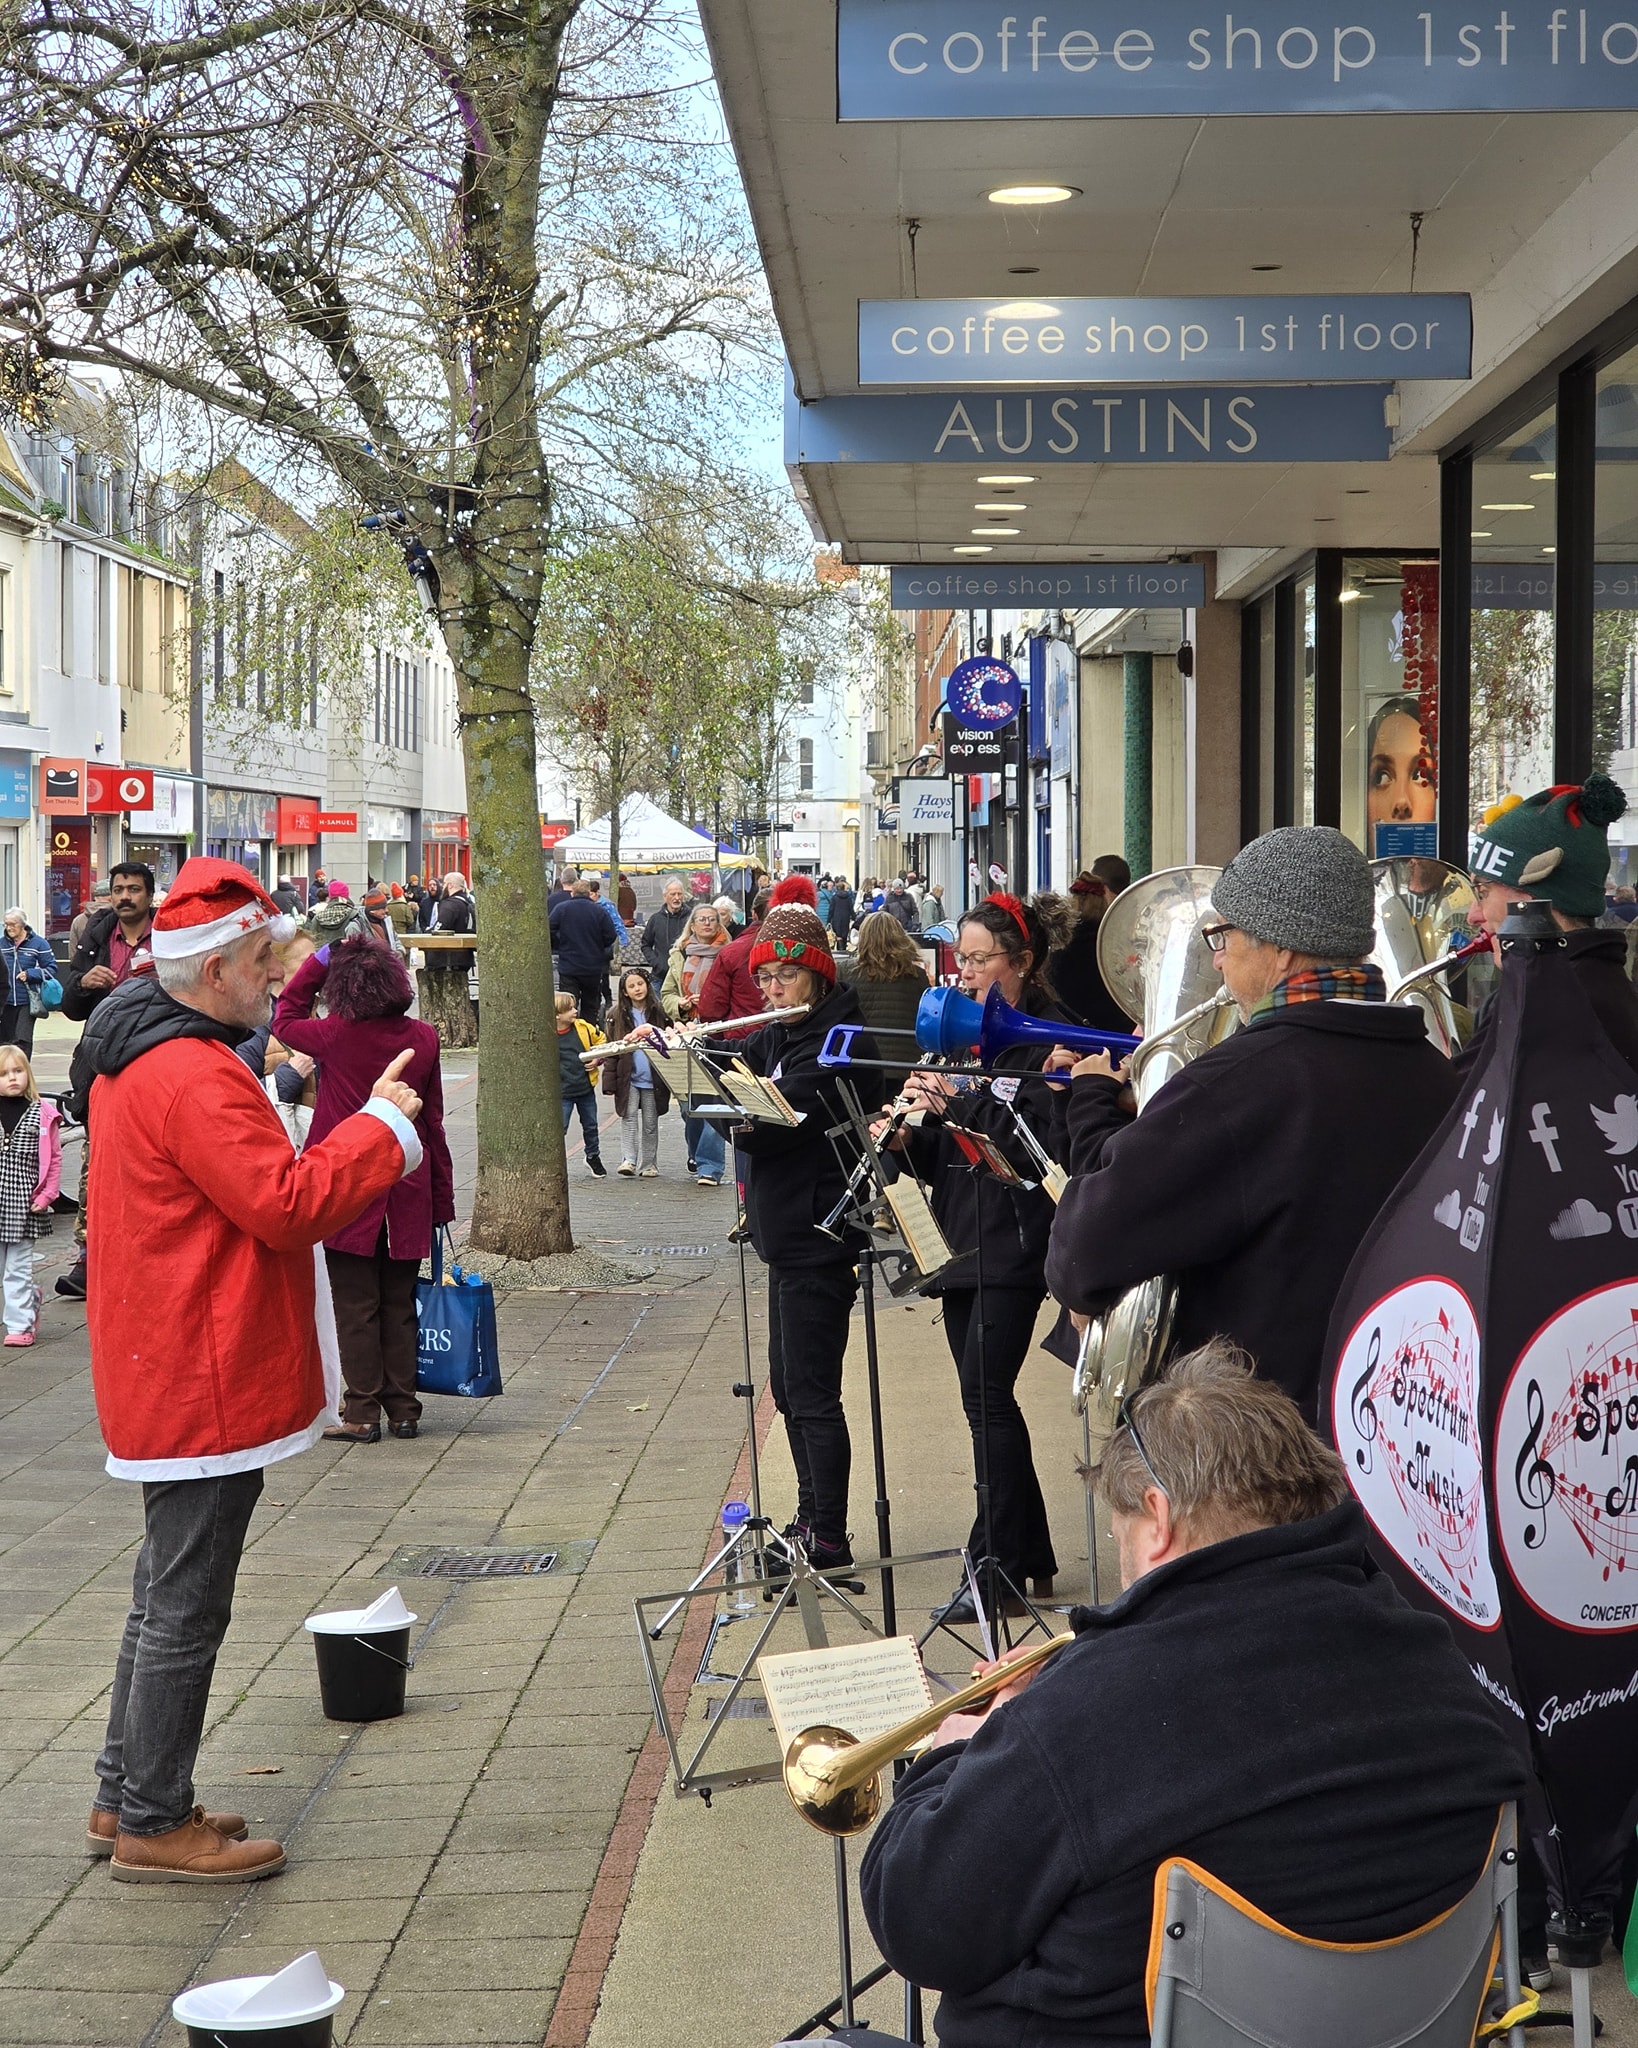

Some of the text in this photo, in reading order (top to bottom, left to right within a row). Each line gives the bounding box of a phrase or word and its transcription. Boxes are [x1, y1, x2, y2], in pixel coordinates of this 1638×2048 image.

[888, 8, 1638, 83] coffee shop 1st flo
[891, 313, 1440, 361] coffee shop 1st floor
[933, 396, 1258, 454] AUSTINS
[908, 574, 1190, 598] coffee shop 1st floor
[957, 728, 994, 740] vision
[950, 743, 1001, 756] expess
[918, 794, 952, 808] Hays
[912, 808, 953, 819] Trave
[571, 852, 628, 862] AWESOE
[1393, 1353, 1469, 1446] Spectrum
[1407, 1440, 1465, 1520] Music
[1413, 1557, 1453, 1603] CONCERT
[1580, 1604, 1638, 1621] CONCERT
